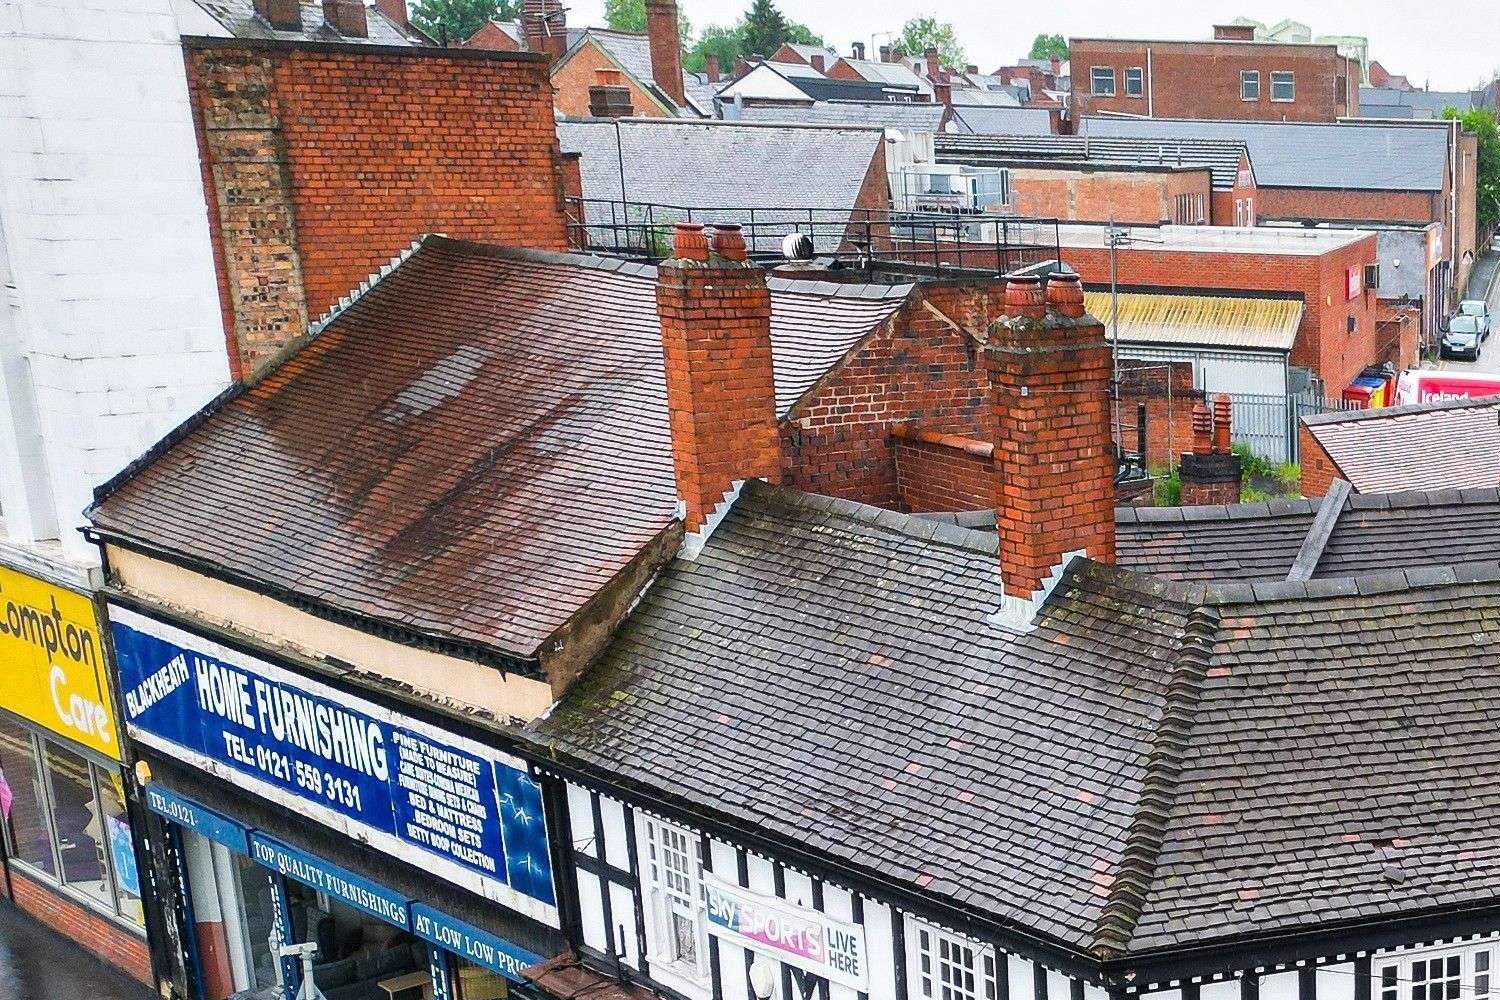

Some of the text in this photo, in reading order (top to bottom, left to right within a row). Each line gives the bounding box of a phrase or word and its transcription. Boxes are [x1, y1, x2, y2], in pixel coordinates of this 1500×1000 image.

[1421, 389, 1468, 405] Iceland
[50, 664, 111, 744] Care
[126, 653, 190, 718] BLACKHEATH
[194, 657, 389, 782] HOME FURNISHING
[222, 731, 362, 812] TEL: 0121 559 3131
[420, 740, 480, 775] FURNITURE
[415, 809, 482, 848] BEDROOM SETS
[451, 841, 495, 872] COLLECTION
[254, 841, 275, 865] TOP
[278, 852, 324, 887] QUALITY
[326, 872, 406, 924] FURNISHINGS
[709, 890, 737, 929] sky
[415, 914, 430, 935] AT
[434, 922, 462, 950] LOW
[465, 936, 494, 965] LOW
[827, 927, 858, 956] LIVE
[829, 950, 860, 977] HERE
